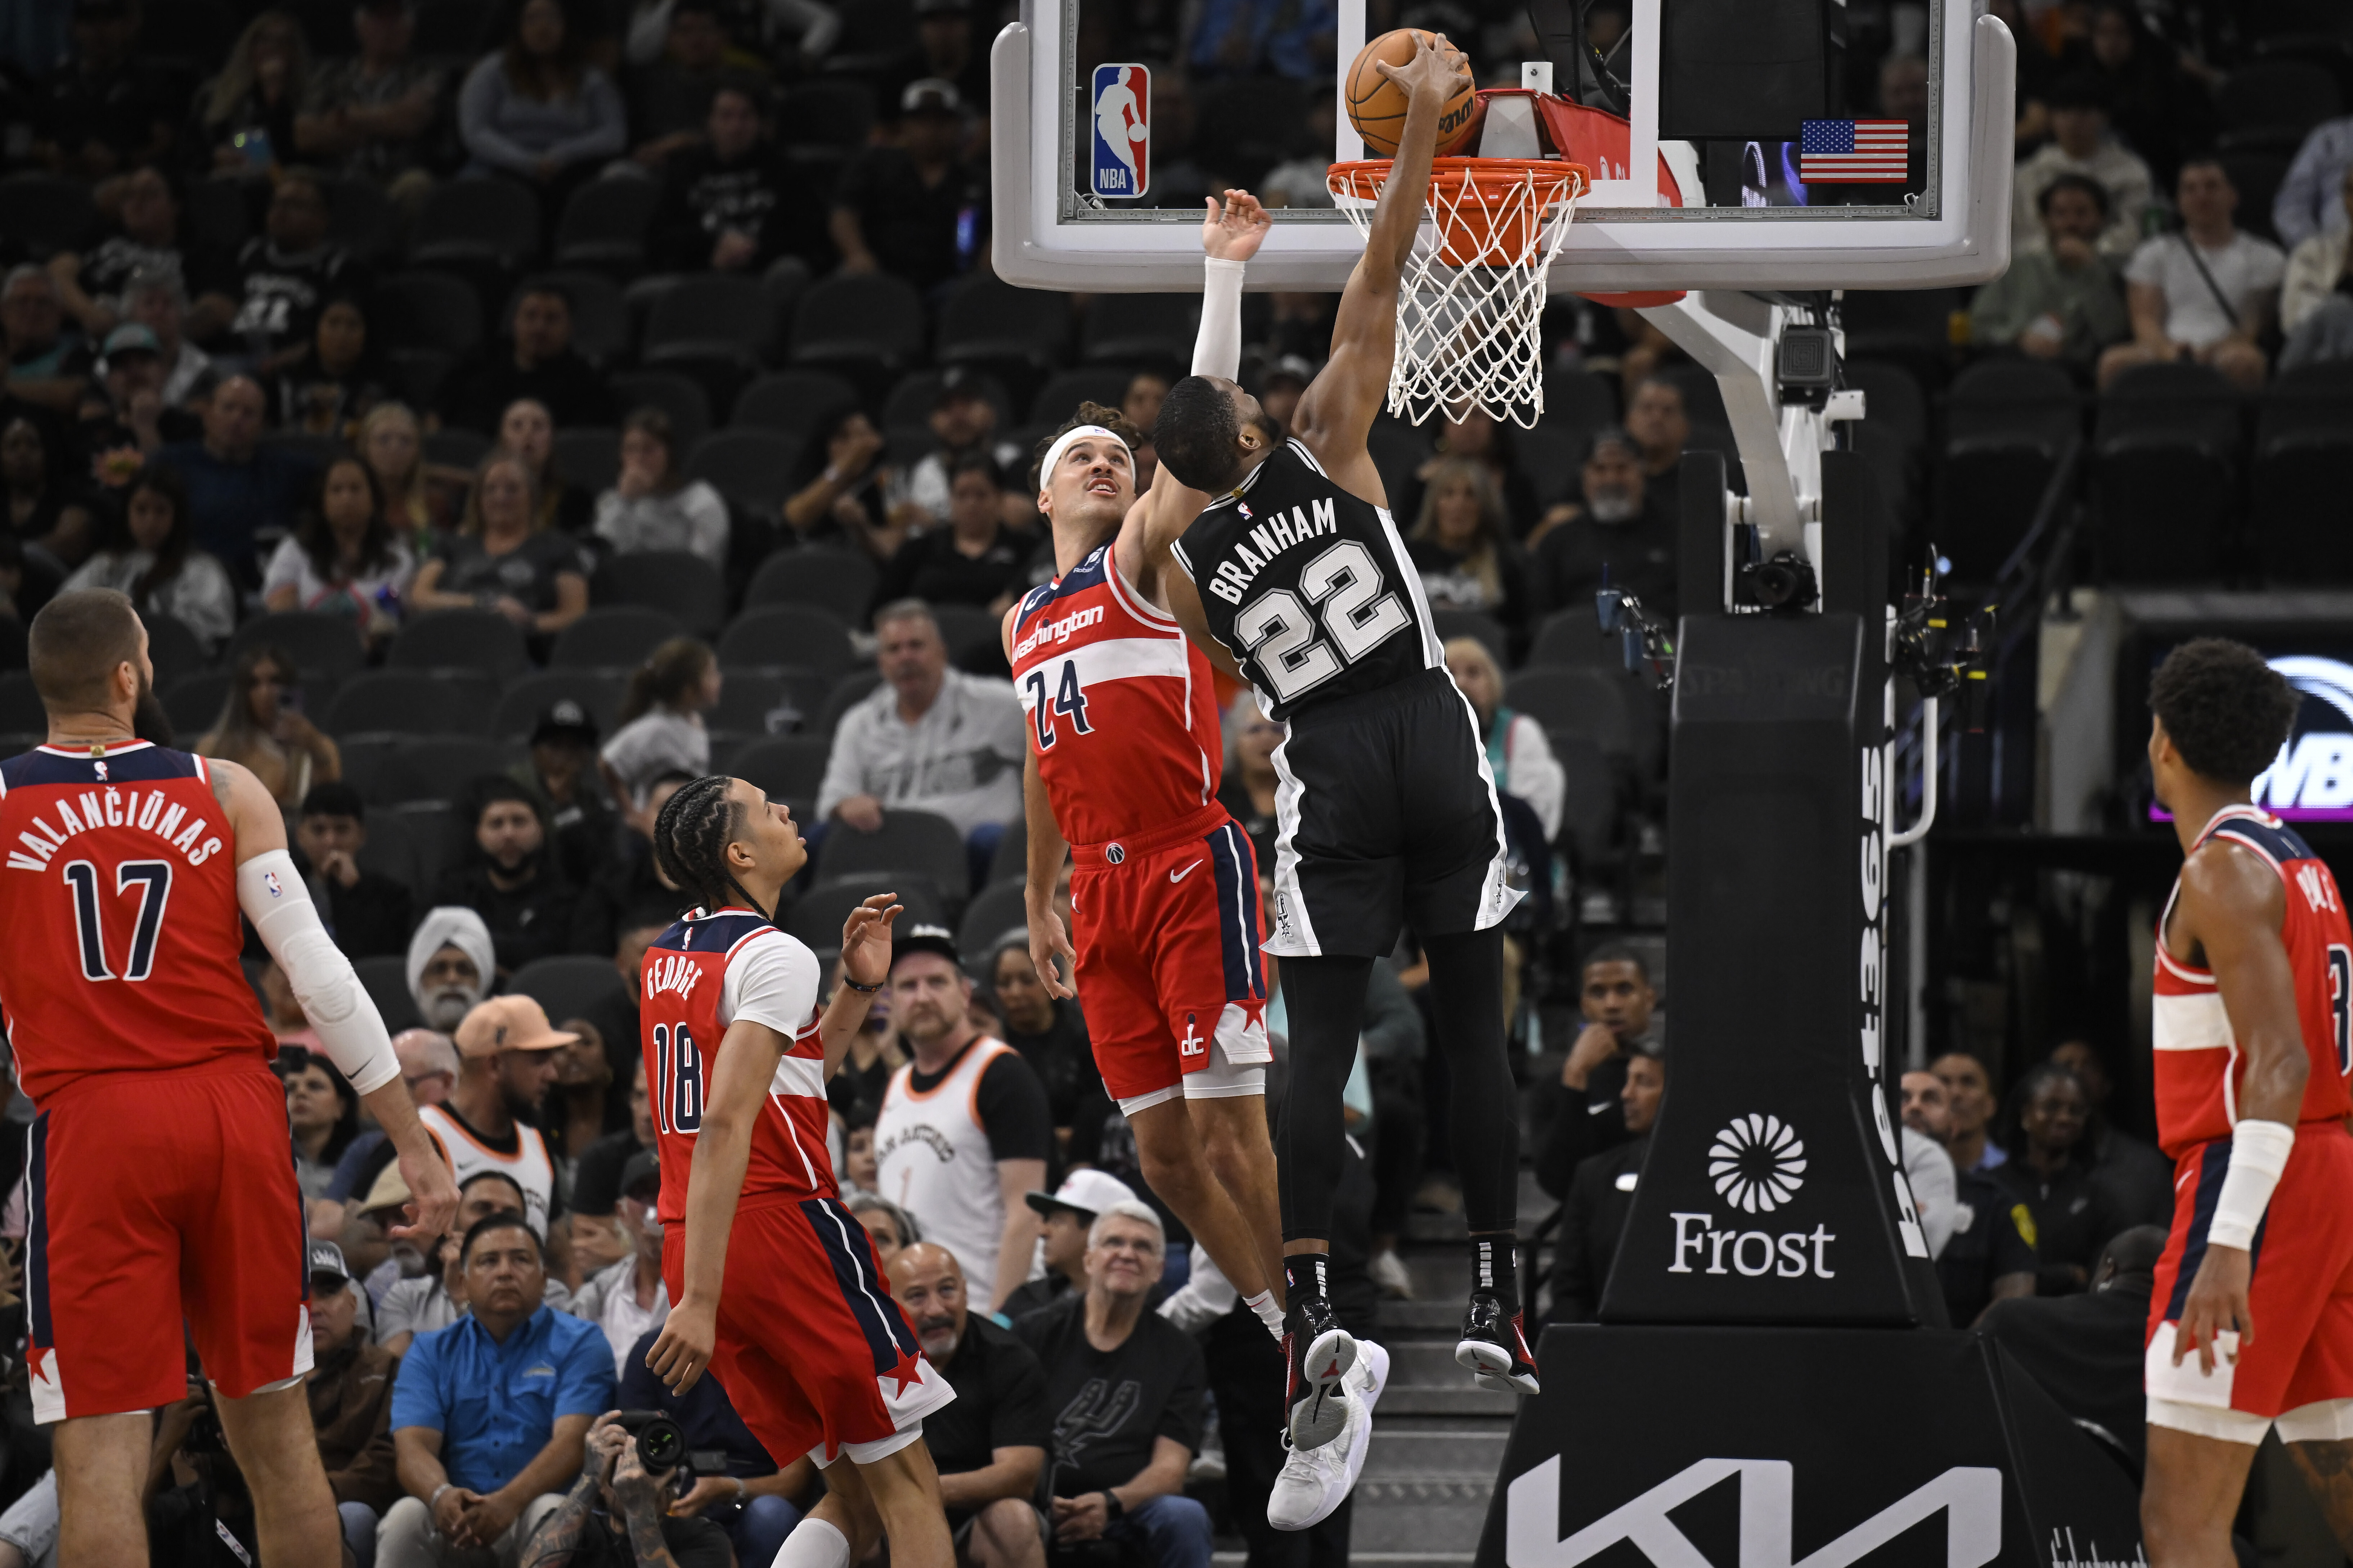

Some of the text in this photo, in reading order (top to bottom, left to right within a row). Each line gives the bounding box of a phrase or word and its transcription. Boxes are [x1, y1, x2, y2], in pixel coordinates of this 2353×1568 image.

[1100, 168, 1126, 189] NBA
[1209, 497, 1337, 605] BRANHAM
[1234, 539, 1412, 703] 22
[1026, 659, 1095, 752] 24
[6, 786, 223, 872] VALANČIŪNAS
[63, 859, 173, 982] 17
[648, 955, 703, 1002] GEORGE
[653, 1021, 704, 1134] 18
[1667, 1212, 1837, 1279] Frost
